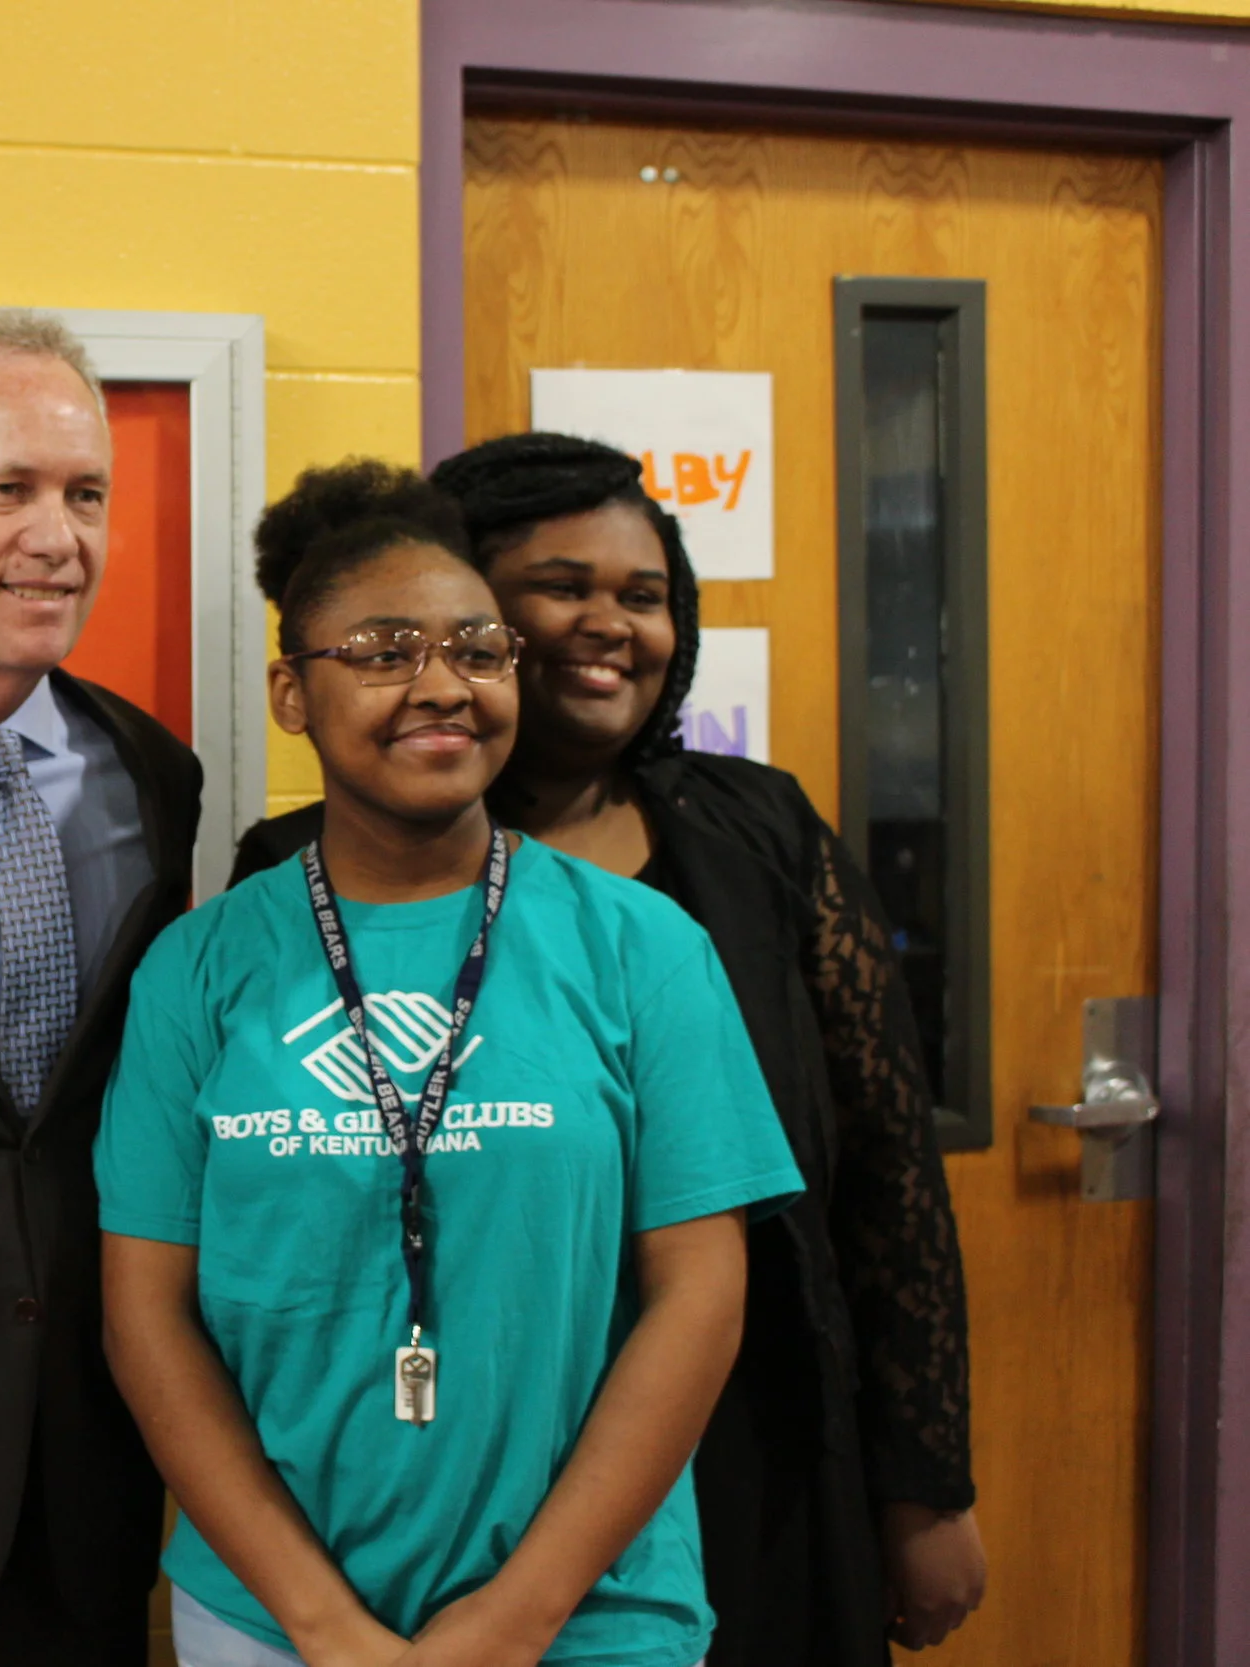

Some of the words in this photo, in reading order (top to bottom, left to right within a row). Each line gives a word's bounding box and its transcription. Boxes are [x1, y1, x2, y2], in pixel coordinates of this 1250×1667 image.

[627, 449, 753, 512] LBY
[317, 909, 348, 971] BEARS
[212, 1108, 292, 1140] BOYS
[297, 1108, 330, 1134] &
[334, 1108, 384, 1135] GI
[442, 1101, 555, 1130] CLUBS
[269, 1136, 305, 1157] OF
